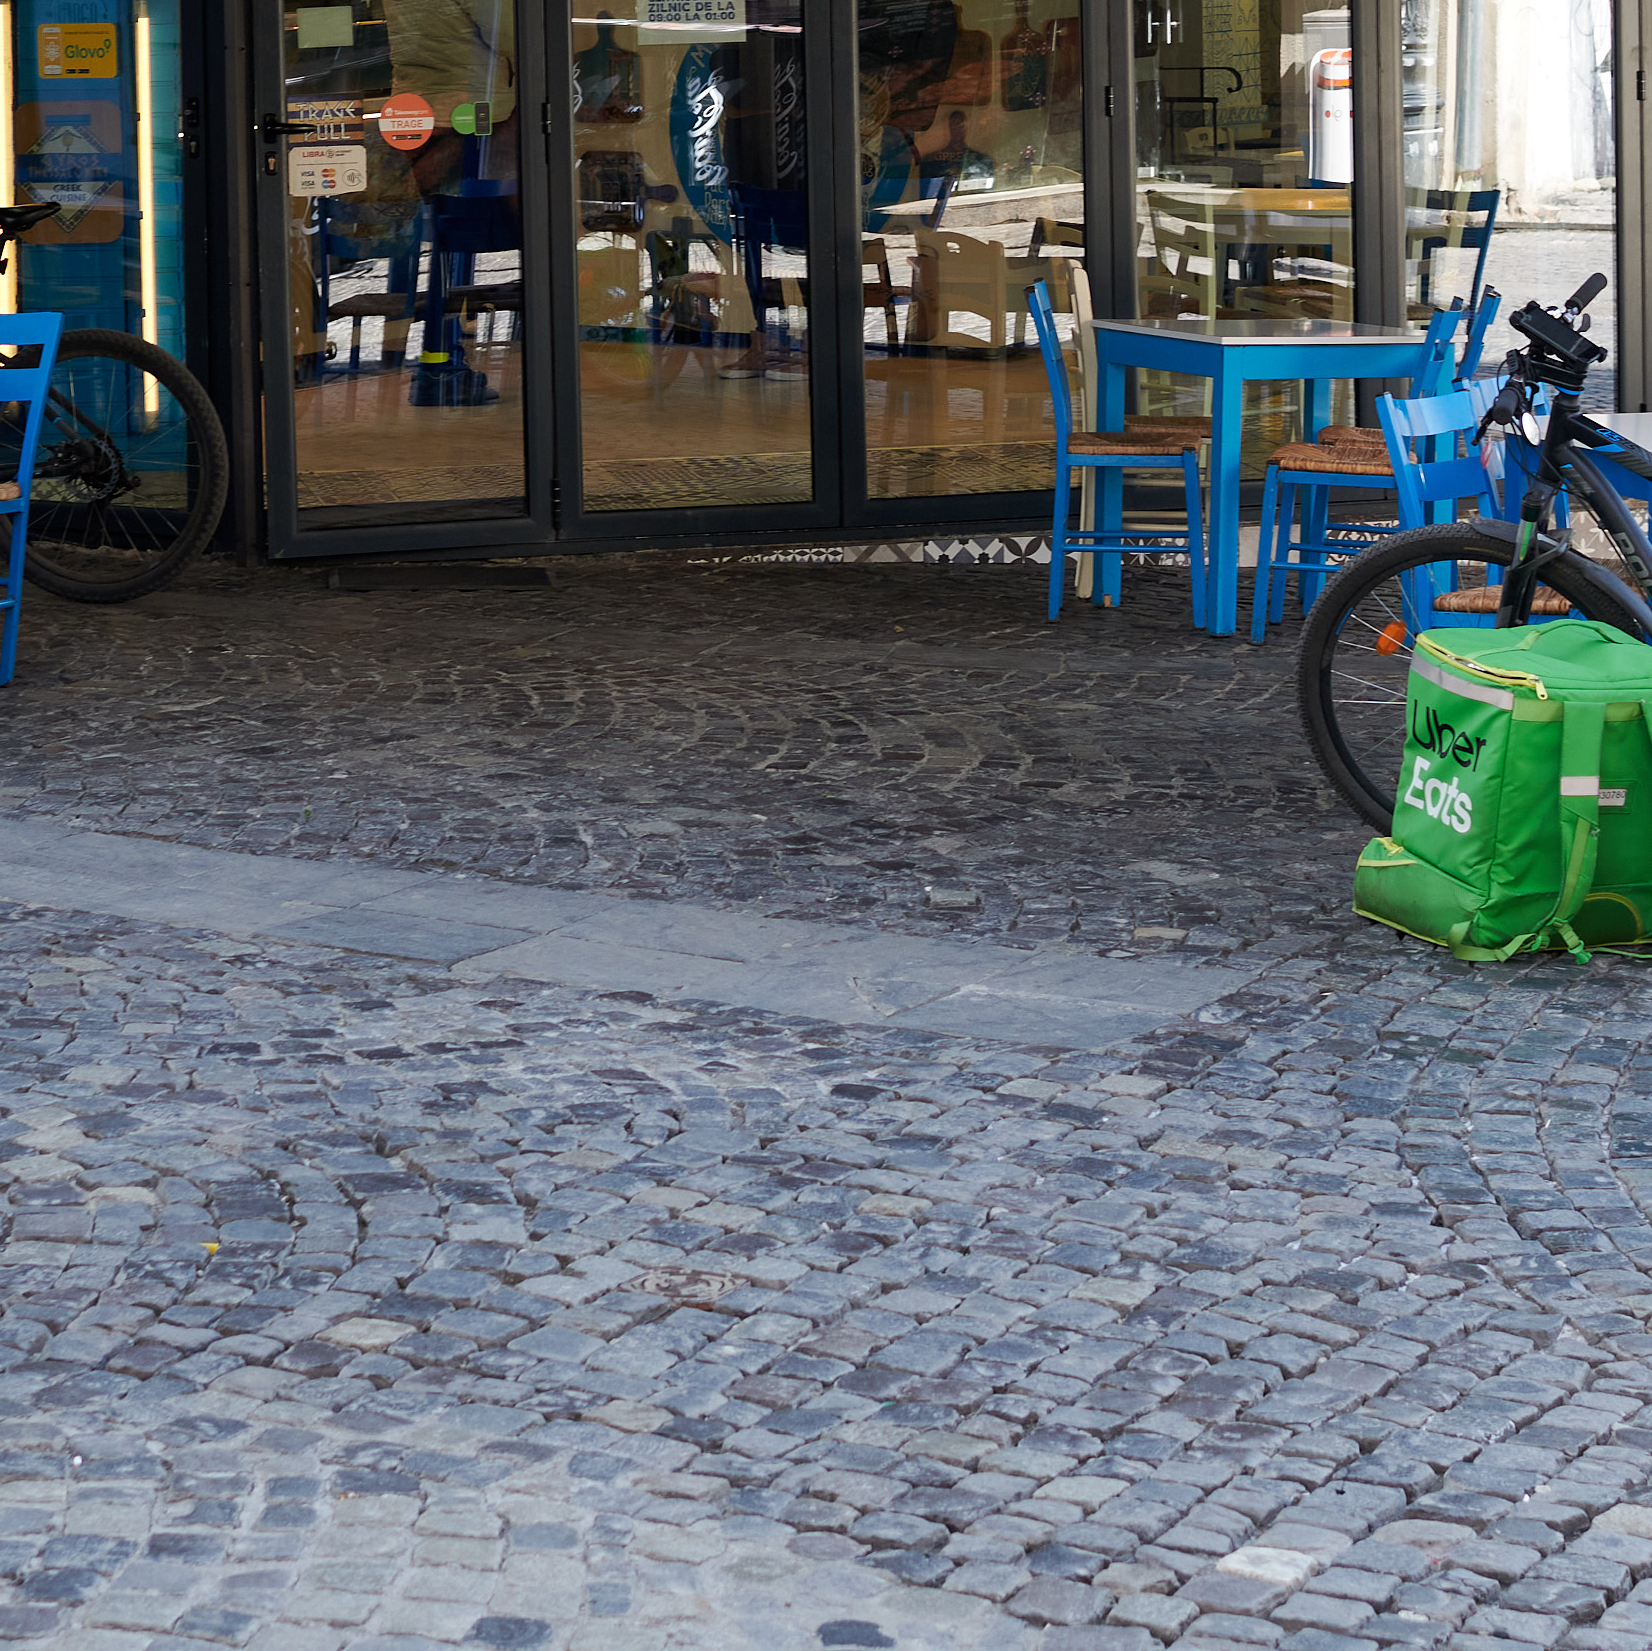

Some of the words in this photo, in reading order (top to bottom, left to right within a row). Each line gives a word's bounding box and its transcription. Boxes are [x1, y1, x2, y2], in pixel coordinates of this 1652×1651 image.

[648, 2, 690, 13] ZILNIC
[695, 2, 712, 11] DE
[717, 1, 735, 11] LA
[685, 12, 700, 21] LA
[64, 45, 105, 59] Glovo
[296, 101, 356, 121] TRAGE
[391, 119, 423, 128] TRAGE
[1413, 699, 1487, 772] Uber
[1404, 755, 1473, 834] Eats
